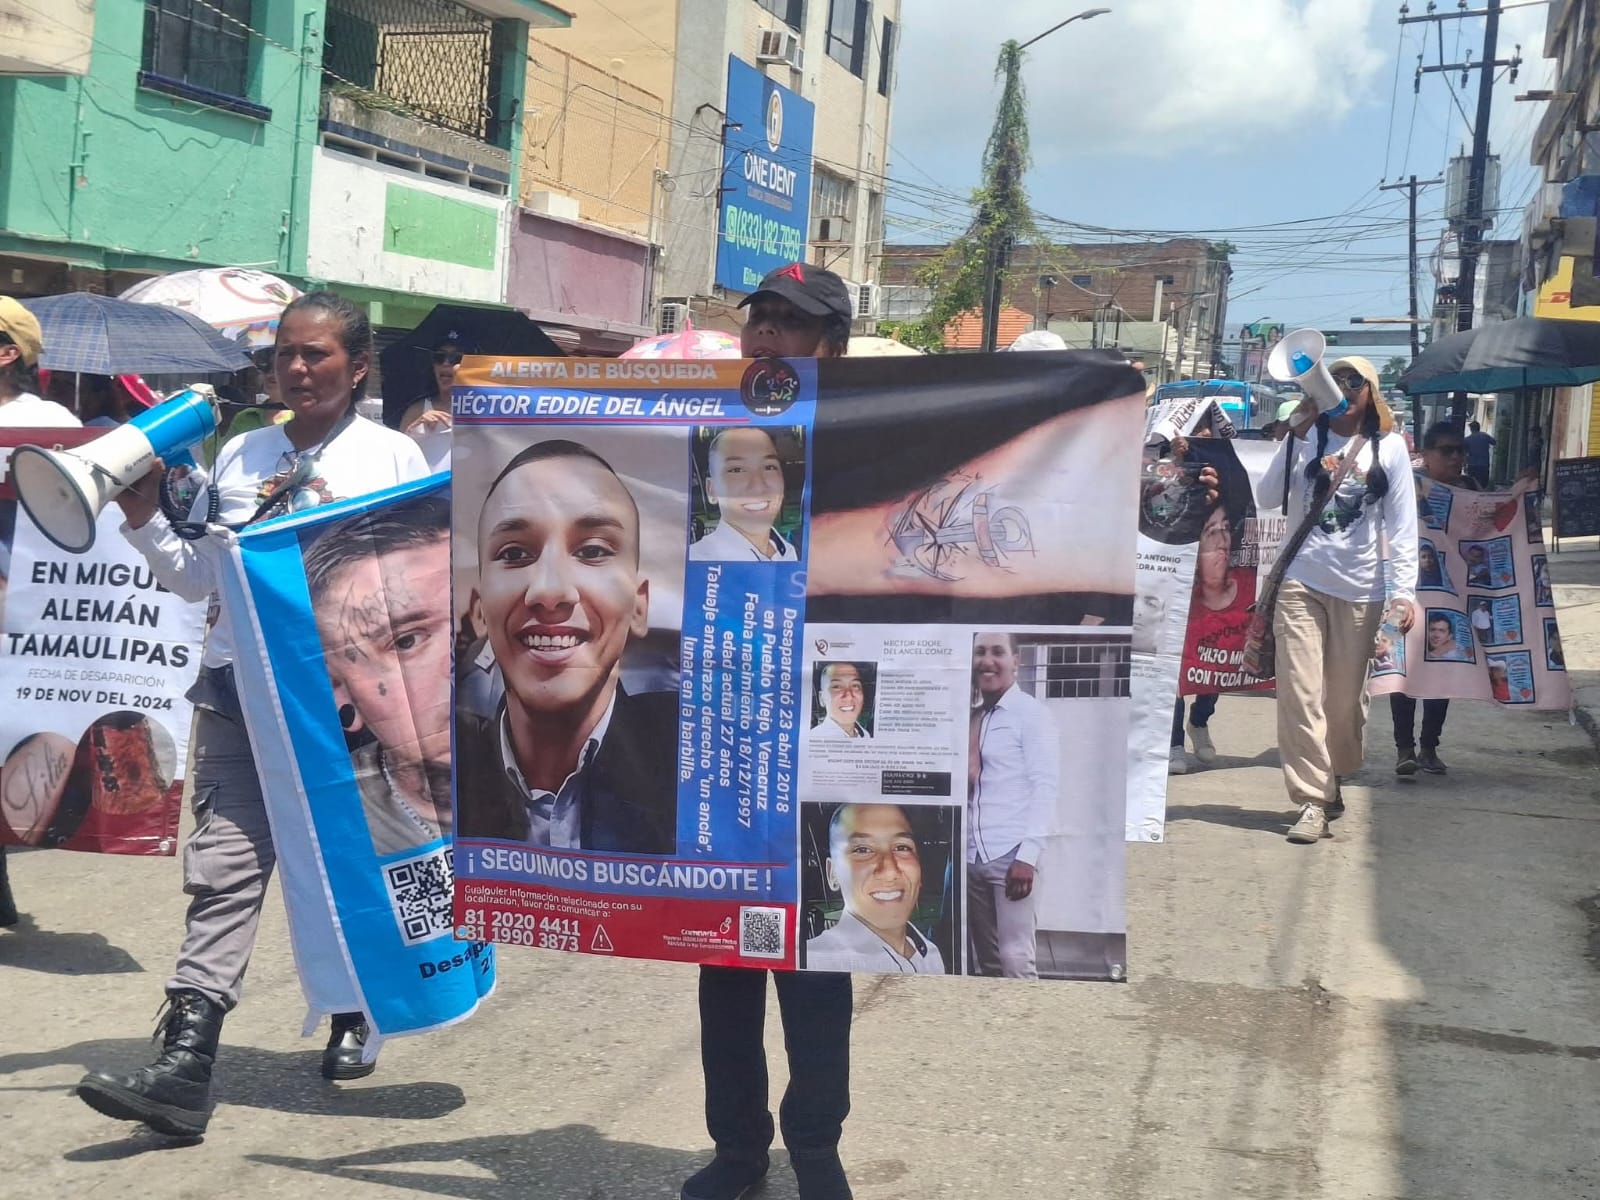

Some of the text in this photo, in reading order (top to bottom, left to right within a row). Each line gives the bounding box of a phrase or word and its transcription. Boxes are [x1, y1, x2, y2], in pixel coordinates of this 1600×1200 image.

[744, 156, 797, 197] ONE DENT
[736, 207, 801, 262] (833) 182 7959
[490, 360, 718, 384] ALERTA DE BÚSQUEDA
[451, 391, 726, 417] HÉCTOR EDDIE DEL ÁNGEL
[1144, 554, 1181, 564] ANTONIO
[31, 561, 170, 593] EN MIGU
[702, 565, 721, 621] Tatuaje
[41, 594, 160, 628] ALEMÁN
[8, 633, 190, 668] TAMAULIPAS
[701, 624, 717, 702] antebrazo
[1229, 650, 1244, 665] MI
[28, 668, 165, 688] FECHA DE DESAPARICIÓN
[1187, 667, 1211, 685] CON
[1214, 671, 1242, 687] TODA
[16, 687, 172, 711] 19 DE NOV DEL 2024
[680, 636, 698, 783] lunar en la barbilla.
[719, 631, 736, 787] edad actual 27 años
[737, 592, 759, 828] Fecha nacimiento 18/12/1997
[756, 610, 777, 810] en Pueblo Viejo, Veracruz
[776, 607, 797, 813] Desapareció 23 abril 2018
[700, 706, 715, 769] derecho
[481, 848, 588, 881] SEGUIMOS
[594, 862, 759, 891] BUSCÁNDOTE
[544, 901, 555, 910] de
[612, 902, 629, 910] con
[631, 903, 642, 911] su
[465, 909, 581, 937] 81 2020 4411
[465, 925, 579, 951] 81 1990 3873
[419, 942, 488, 979] Desap
